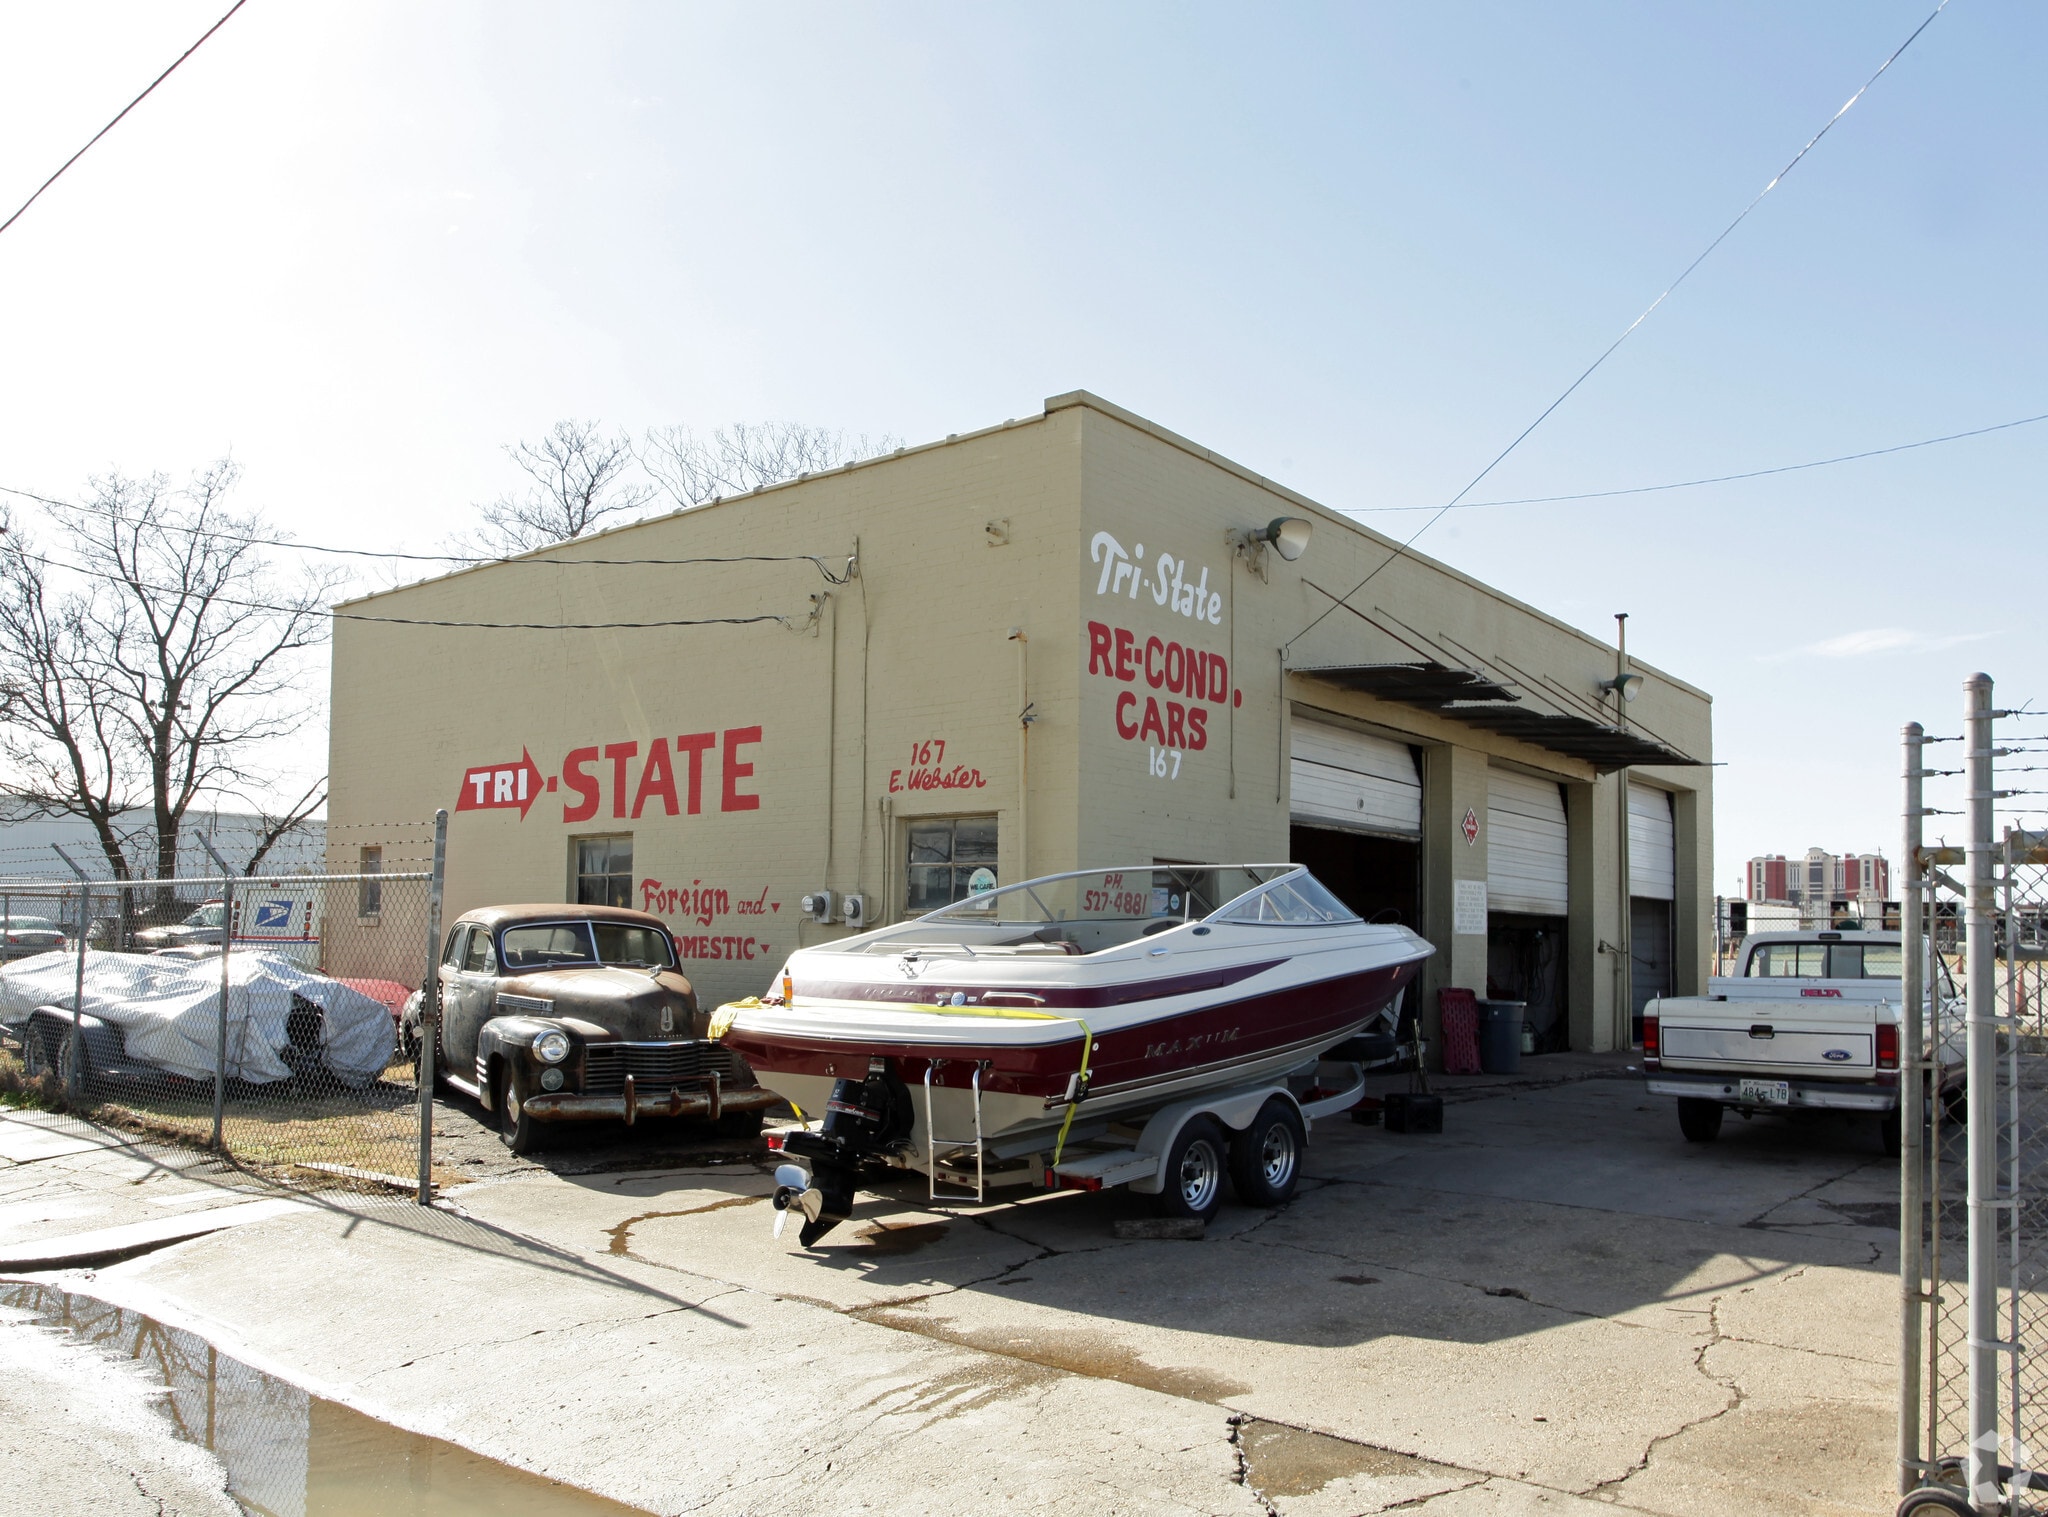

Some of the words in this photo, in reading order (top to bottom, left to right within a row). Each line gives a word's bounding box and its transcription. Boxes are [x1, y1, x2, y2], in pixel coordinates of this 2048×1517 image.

[1116, 691, 1208, 751] CARS
[911, 739, 945, 766] 167
[1149, 746, 1182, 780] 167
[889, 769, 904, 793] E.
[908, 765, 987, 791] Webster
[639, 878, 730, 927] Foreign
[737, 885, 769, 915] and
[673, 935, 756, 960] OMESTIC
[1828, 1052, 1846, 1060] Ford
